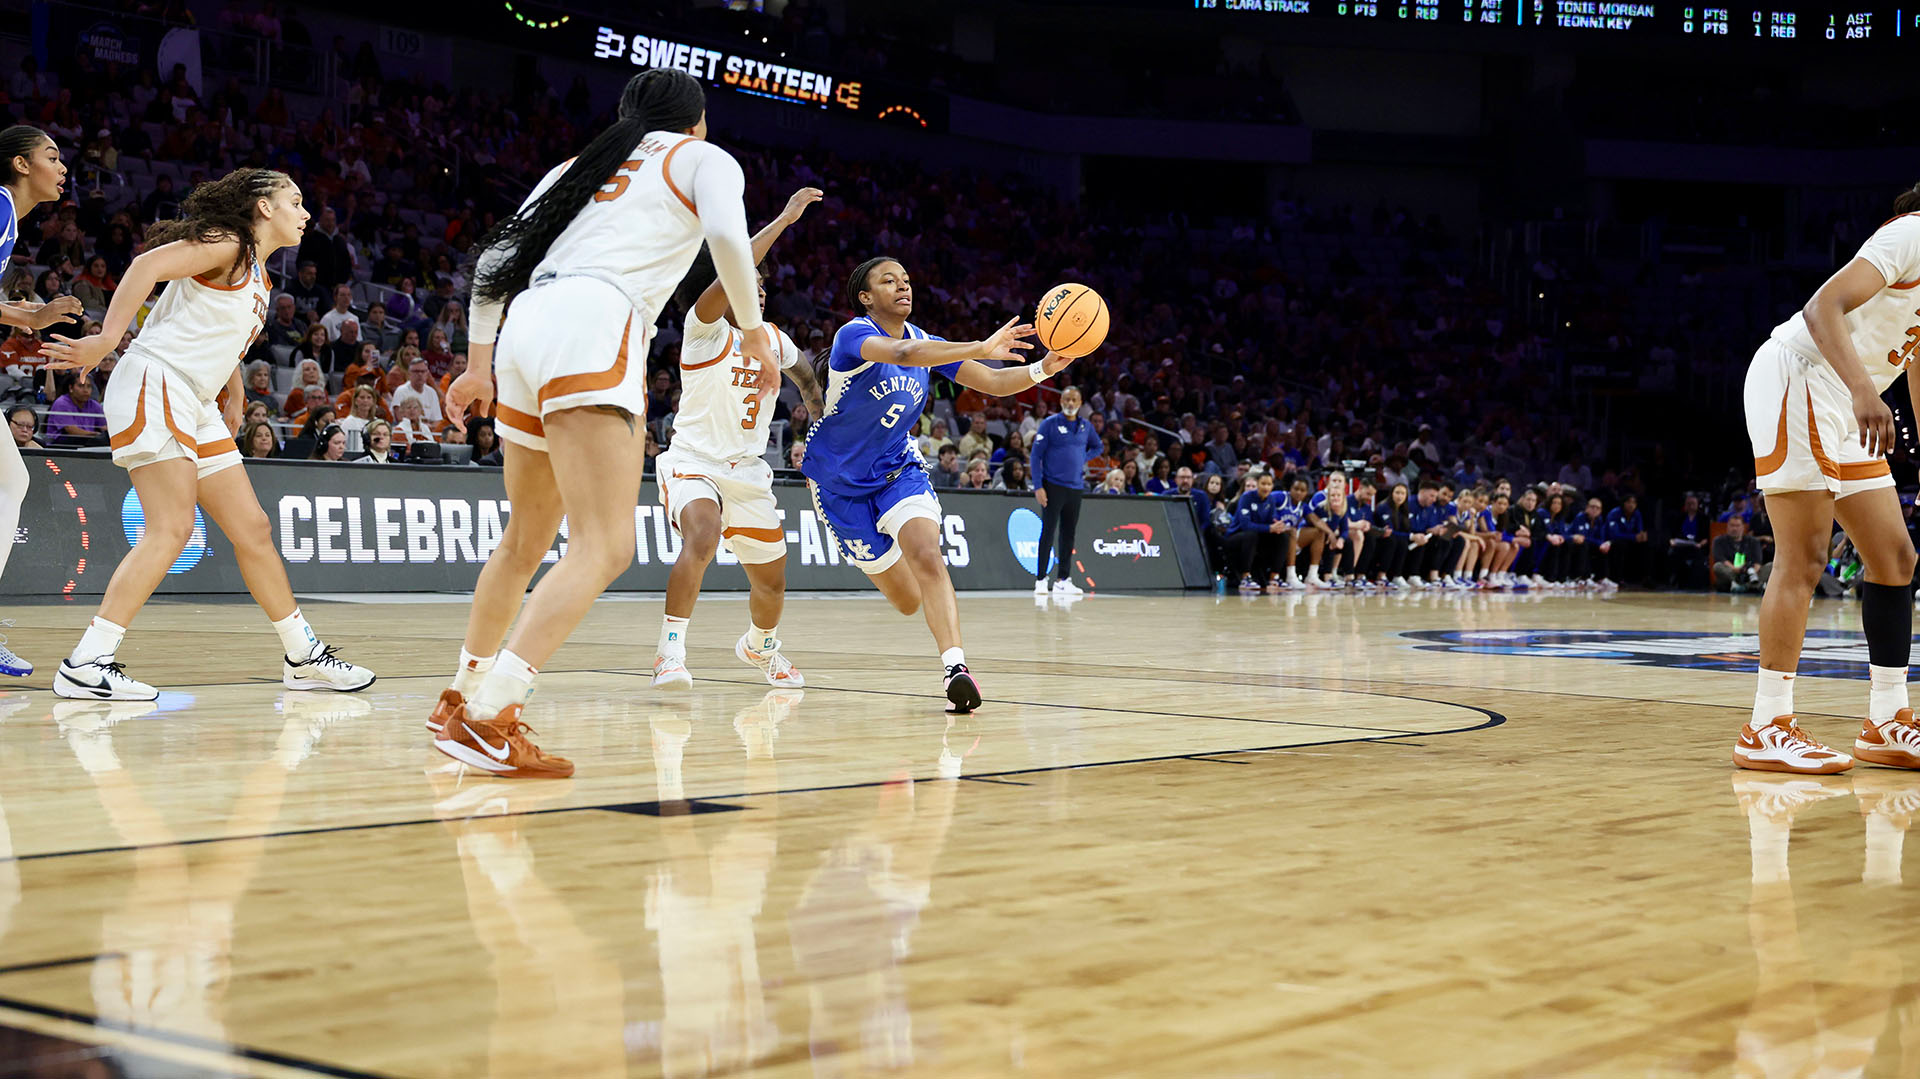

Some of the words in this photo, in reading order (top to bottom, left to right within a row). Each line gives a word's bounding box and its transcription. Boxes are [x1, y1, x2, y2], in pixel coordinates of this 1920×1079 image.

[1225, 0, 1262, 10] CLARA
[1264, 1, 1309, 13] STRACK
[1354, 4, 1377, 16] PTS
[1415, 7, 1439, 20] REB
[1480, 11, 1502, 23] AST
[1557, 1, 1596, 14] TONIE
[1599, 3, 1654, 17] MORGAN
[1684, 7, 1693, 19] 0
[1703, 8, 1728, 21] PTS
[1752, 10, 1762, 22] 0
[1771, 12, 1796, 24] REB
[1829, 14, 1835, 26] 1
[1846, 12, 1872, 26] AST
[1534, 13, 1543, 25] 7
[1557, 14, 1604, 28] TEONNI
[1607, 17, 1632, 30] KEY
[1683, 20, 1693, 33] 0
[1703, 21, 1728, 34] PTS
[1754, 24, 1761, 36] 1
[1770, 25, 1796, 38] REB
[1826, 27, 1835, 40] 0
[1845, 26, 1872, 39] AST
[90, 34, 122, 49] MARCH
[386, 30, 419, 54] 109
[95, 48, 138, 64] MADNESS
[630, 34, 722, 81] SWEET
[723, 55, 832, 103] SIXTEEN
[1043, 288, 1072, 321] NCAA
[741, 393, 760, 429] 3
[880, 403, 906, 429] 5
